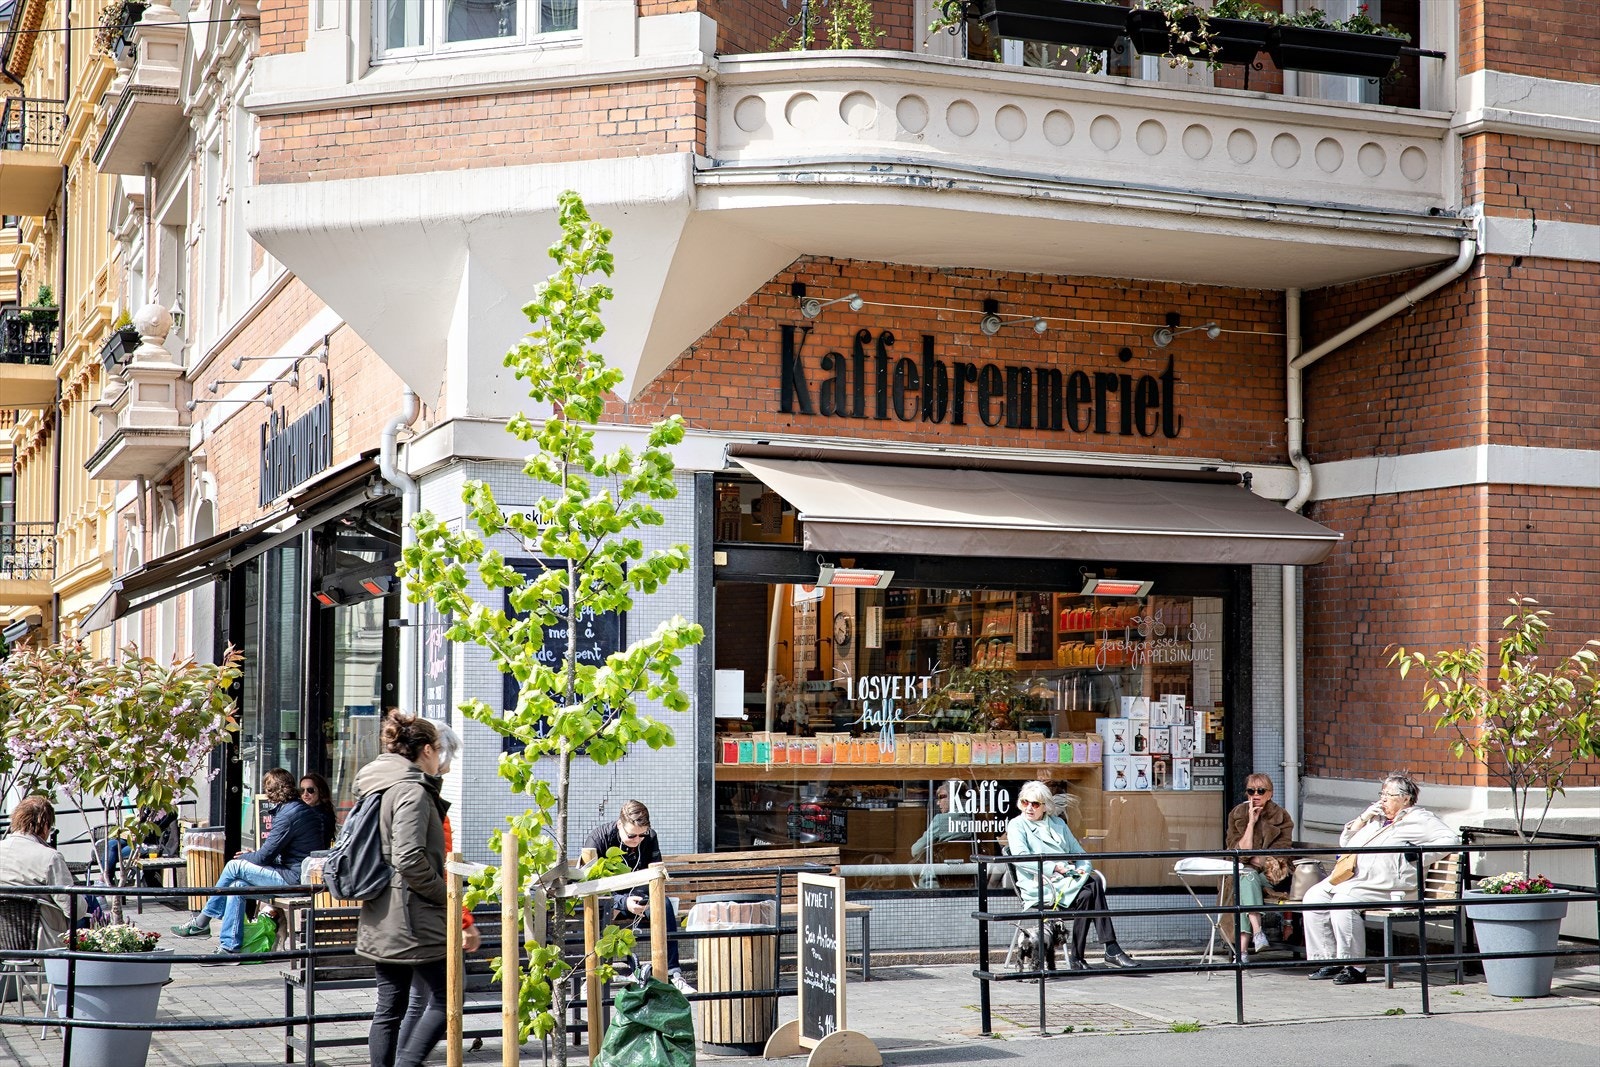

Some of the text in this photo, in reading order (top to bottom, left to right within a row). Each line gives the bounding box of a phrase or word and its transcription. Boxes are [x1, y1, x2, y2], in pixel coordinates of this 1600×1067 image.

[778, 323, 1182, 439] Kaffebrenneriet
[584, 621, 595, 638] å
[1139, 648, 1217, 665] APPELSINJUICE
[846, 675, 933, 701] LØSVEKT
[852, 698, 908, 753] kaffe
[947, 779, 1010, 814] Kaffe
